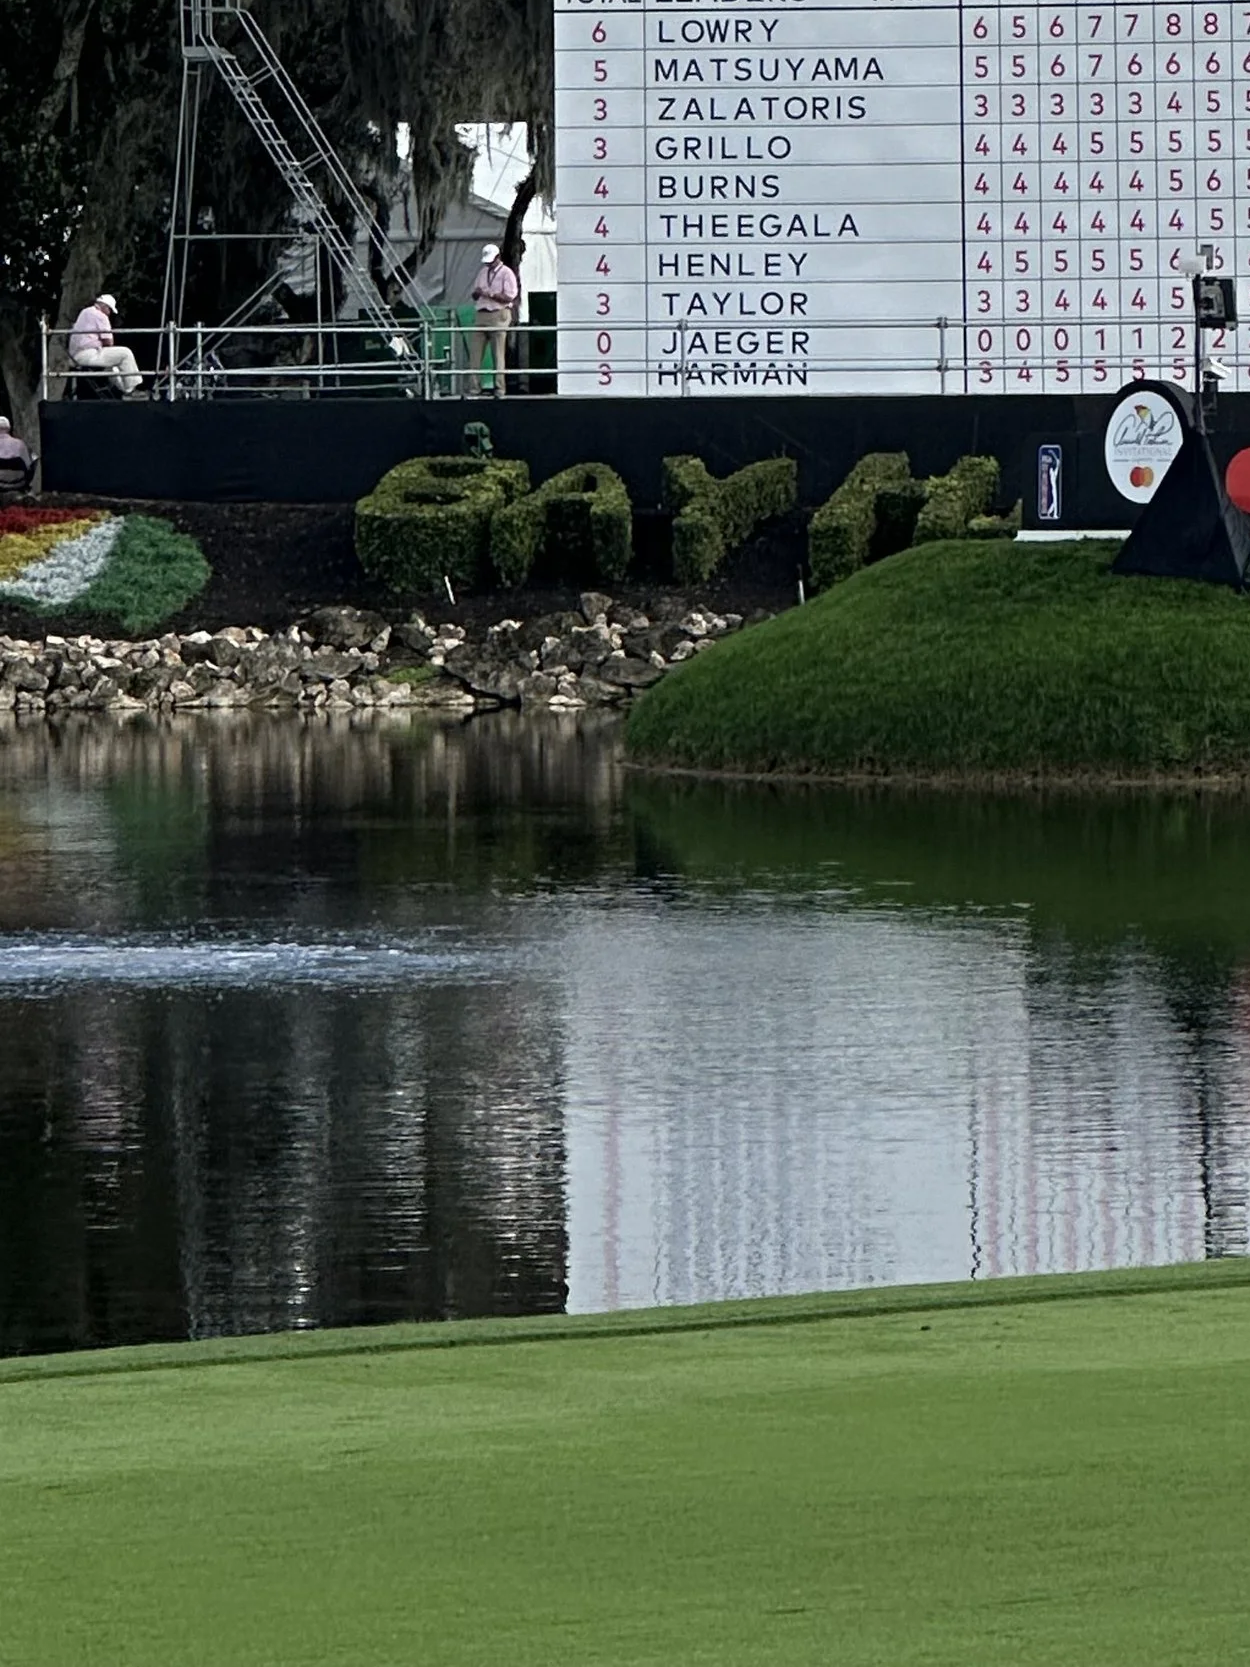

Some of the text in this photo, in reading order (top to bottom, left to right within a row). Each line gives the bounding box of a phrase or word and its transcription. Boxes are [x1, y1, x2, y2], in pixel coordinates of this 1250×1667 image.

[592, 21, 606, 42] 6
[659, 19, 778, 43] LOWRY
[974, 17, 987, 38] 6
[1013, 16, 1025, 38] 5
[1050, 16, 1063, 37] 6
[1088, 16, 1101, 37] 7
[1125, 14, 1138, 36] 7
[1167, 13, 1181, 35] 8
[1204, 13, 1218, 35] 8
[595, 60, 607, 81] 5
[655, 58, 883, 81] MATSUYAMA
[594, 99, 607, 120] 3
[659, 96, 865, 120] ZALATORIS
[975, 95, 988, 117] 3
[1012, 94, 1025, 116] 3
[1051, 93, 1064, 115] 3
[1091, 93, 1103, 115] 3
[1129, 92, 1142, 114] 3
[1167, 92, 1182, 113] 4
[1207, 91, 1220, 112] 5
[593, 138, 606, 159] 3
[656, 136, 790, 159] GRILLO
[594, 177, 608, 198] 4
[659, 175, 779, 198] BURNS
[595, 216, 609, 237] 4
[660, 214, 859, 237] THEEGALA
[977, 213, 991, 234] 4
[1015, 212, 1029, 233] 4
[1053, 212, 1067, 233] 4
[1091, 211, 1105, 232] 4
[1131, 210, 1144, 231] 4
[1169, 209, 1183, 230] 4
[1211, 209, 1223, 230] 5
[596, 255, 610, 274] 4
[659, 253, 807, 276] HENLEY
[597, 293, 610, 315] 3
[662, 292, 807, 315] TAYLOR
[598, 332, 611, 354] 0
[662, 332, 809, 354] JAEGER
[599, 362, 807, 385] 3 HARMAN
